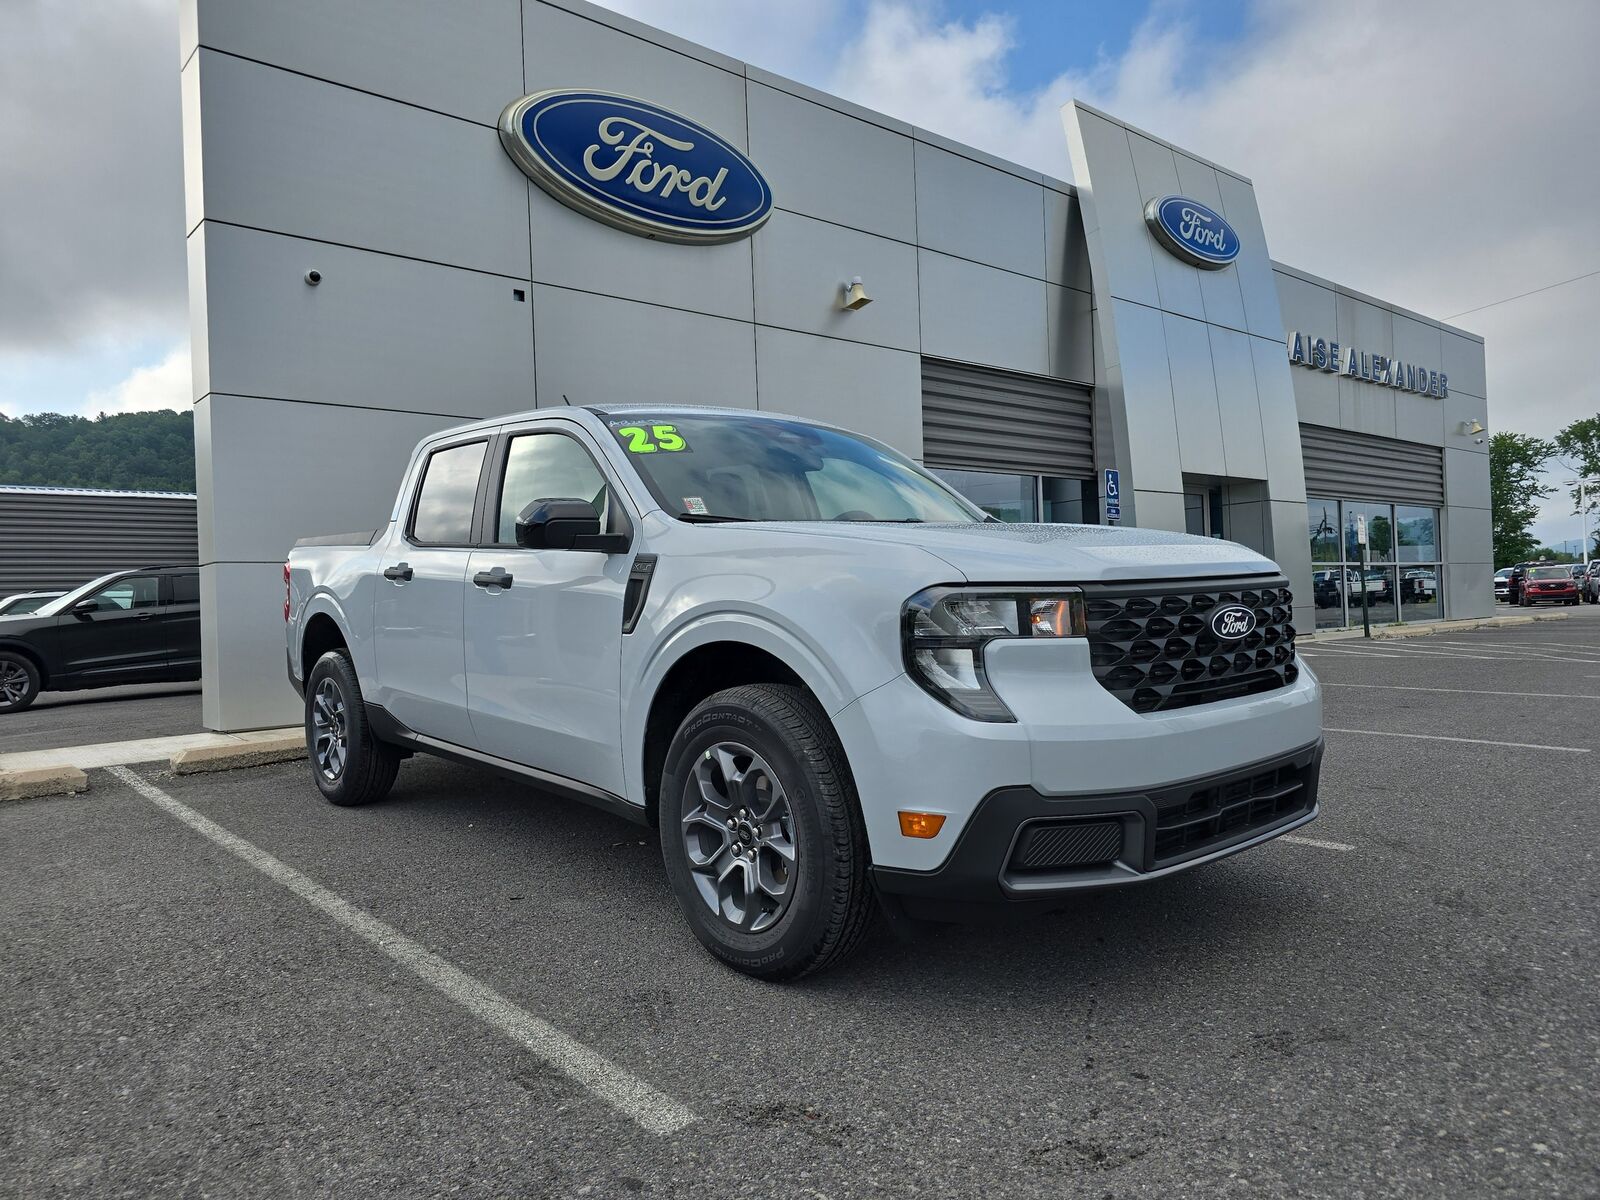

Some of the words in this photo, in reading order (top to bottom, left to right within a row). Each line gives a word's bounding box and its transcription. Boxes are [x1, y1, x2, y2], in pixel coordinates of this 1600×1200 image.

[583, 116, 729, 212] Ford
[1179, 207, 1226, 252] Ford
[1342, 347, 1449, 398] ALEXANDER
[618, 425, 686, 453] 25
[1221, 611, 1249, 634] Ford
